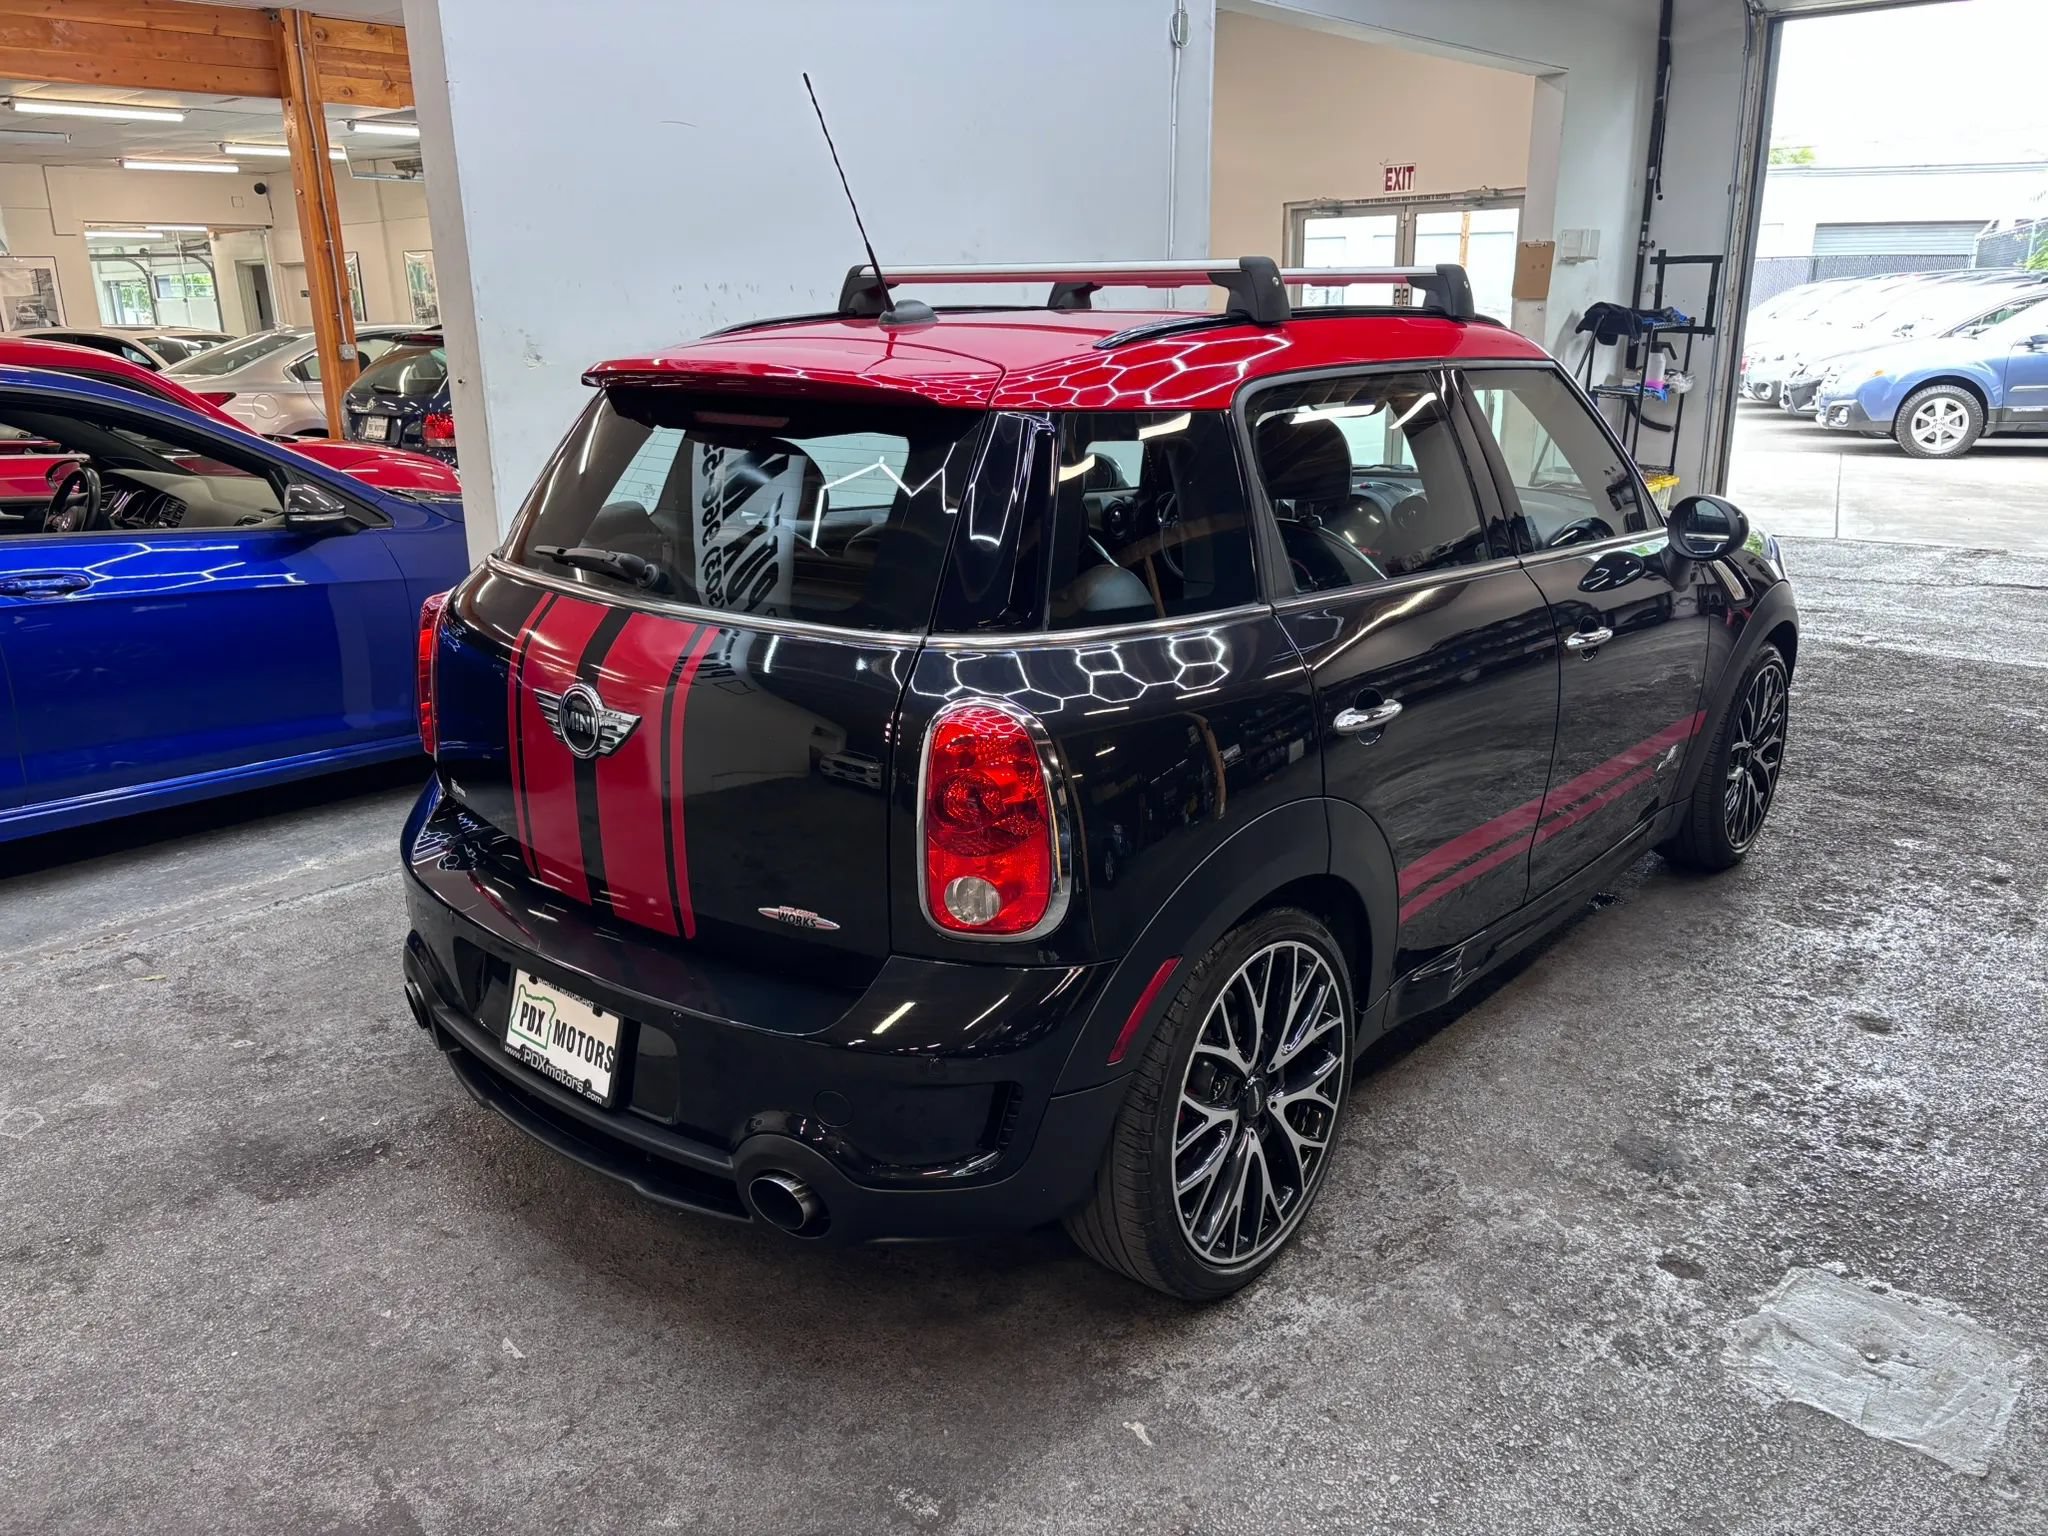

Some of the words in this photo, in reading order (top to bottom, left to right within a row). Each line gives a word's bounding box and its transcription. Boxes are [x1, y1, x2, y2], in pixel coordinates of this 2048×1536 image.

[1385, 166, 1415, 191] EXIT
[563, 709, 596, 735] MINI
[778, 912, 817, 928] WORKS
[519, 1001, 546, 1037] PDX
[552, 1019, 615, 1074] MOTORS
